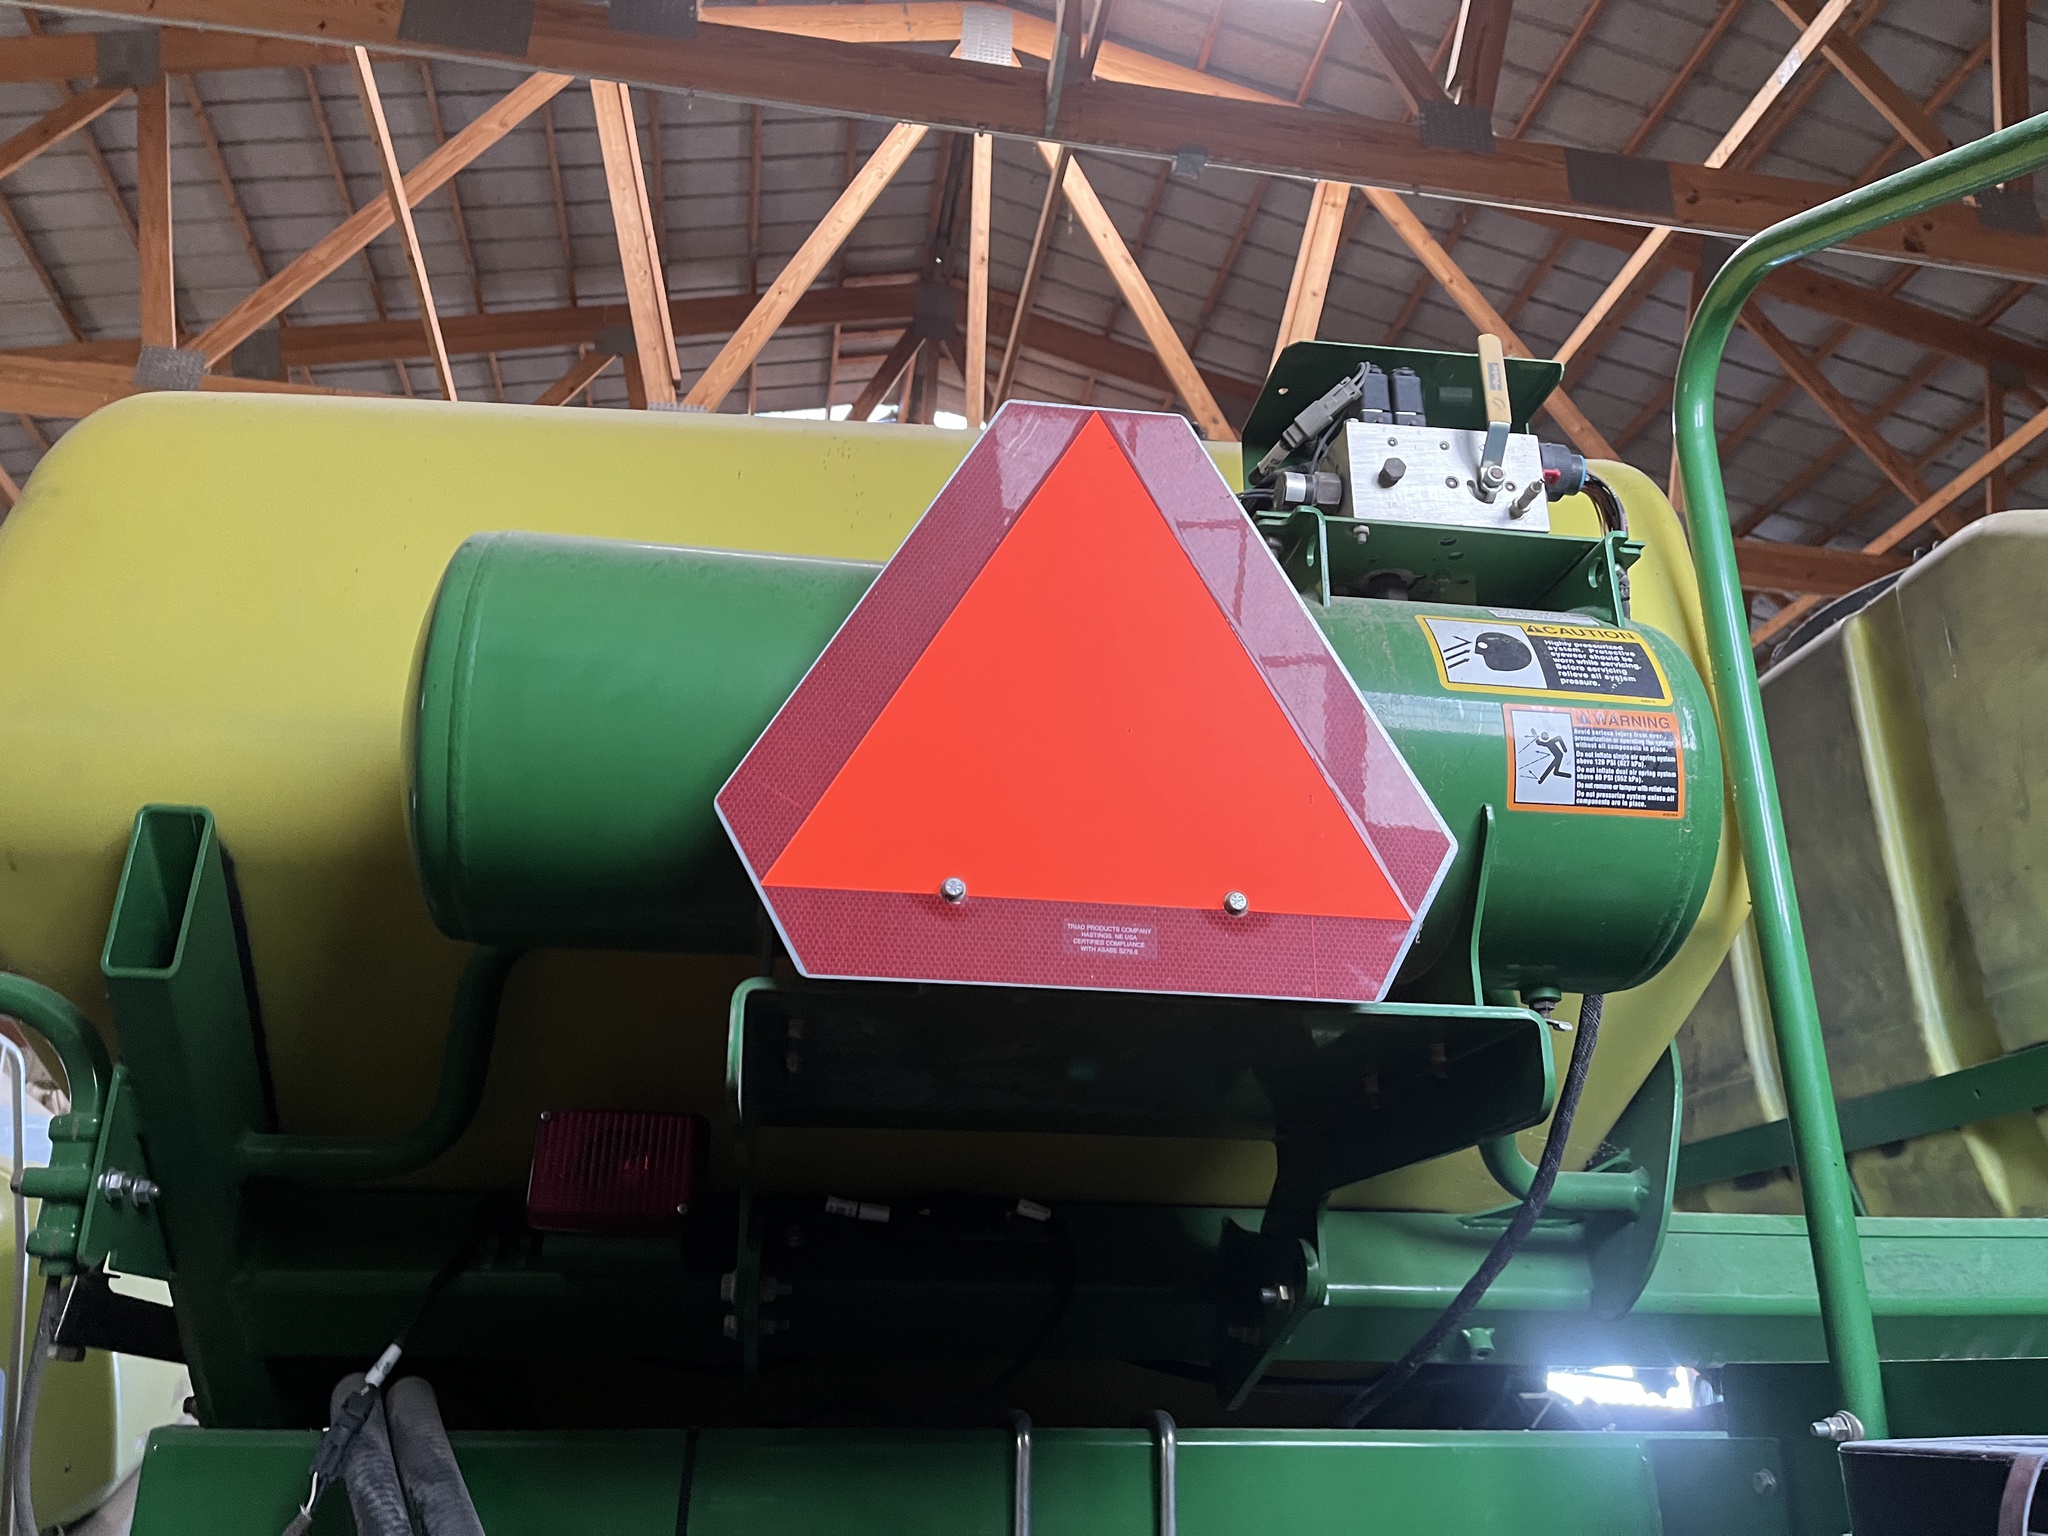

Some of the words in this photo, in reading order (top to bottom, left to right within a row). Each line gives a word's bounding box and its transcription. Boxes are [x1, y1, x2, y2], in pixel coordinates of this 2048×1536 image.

[1542, 626, 1635, 640] CAUTION
[1574, 642, 1624, 650] pressurized
[1589, 648, 1636, 657] Protective
[1555, 664, 1585, 672] Before
[1587, 666, 1628, 675] servicing
[1560, 678, 1600, 686] pressure.
[1593, 714, 1670, 729] WARNING
[1616, 730, 1632, 738] injury
[1613, 752, 1630, 760] single
[1638, 770, 1656, 778] spring
[1596, 792, 1626, 800] pressurize
[1576, 798, 1610, 806] components
[1086, 924, 1120, 932] PRODUCTS
[1121, 926, 1152, 934] COMPANY
[1106, 940, 1146, 948] COMPLIANCE
